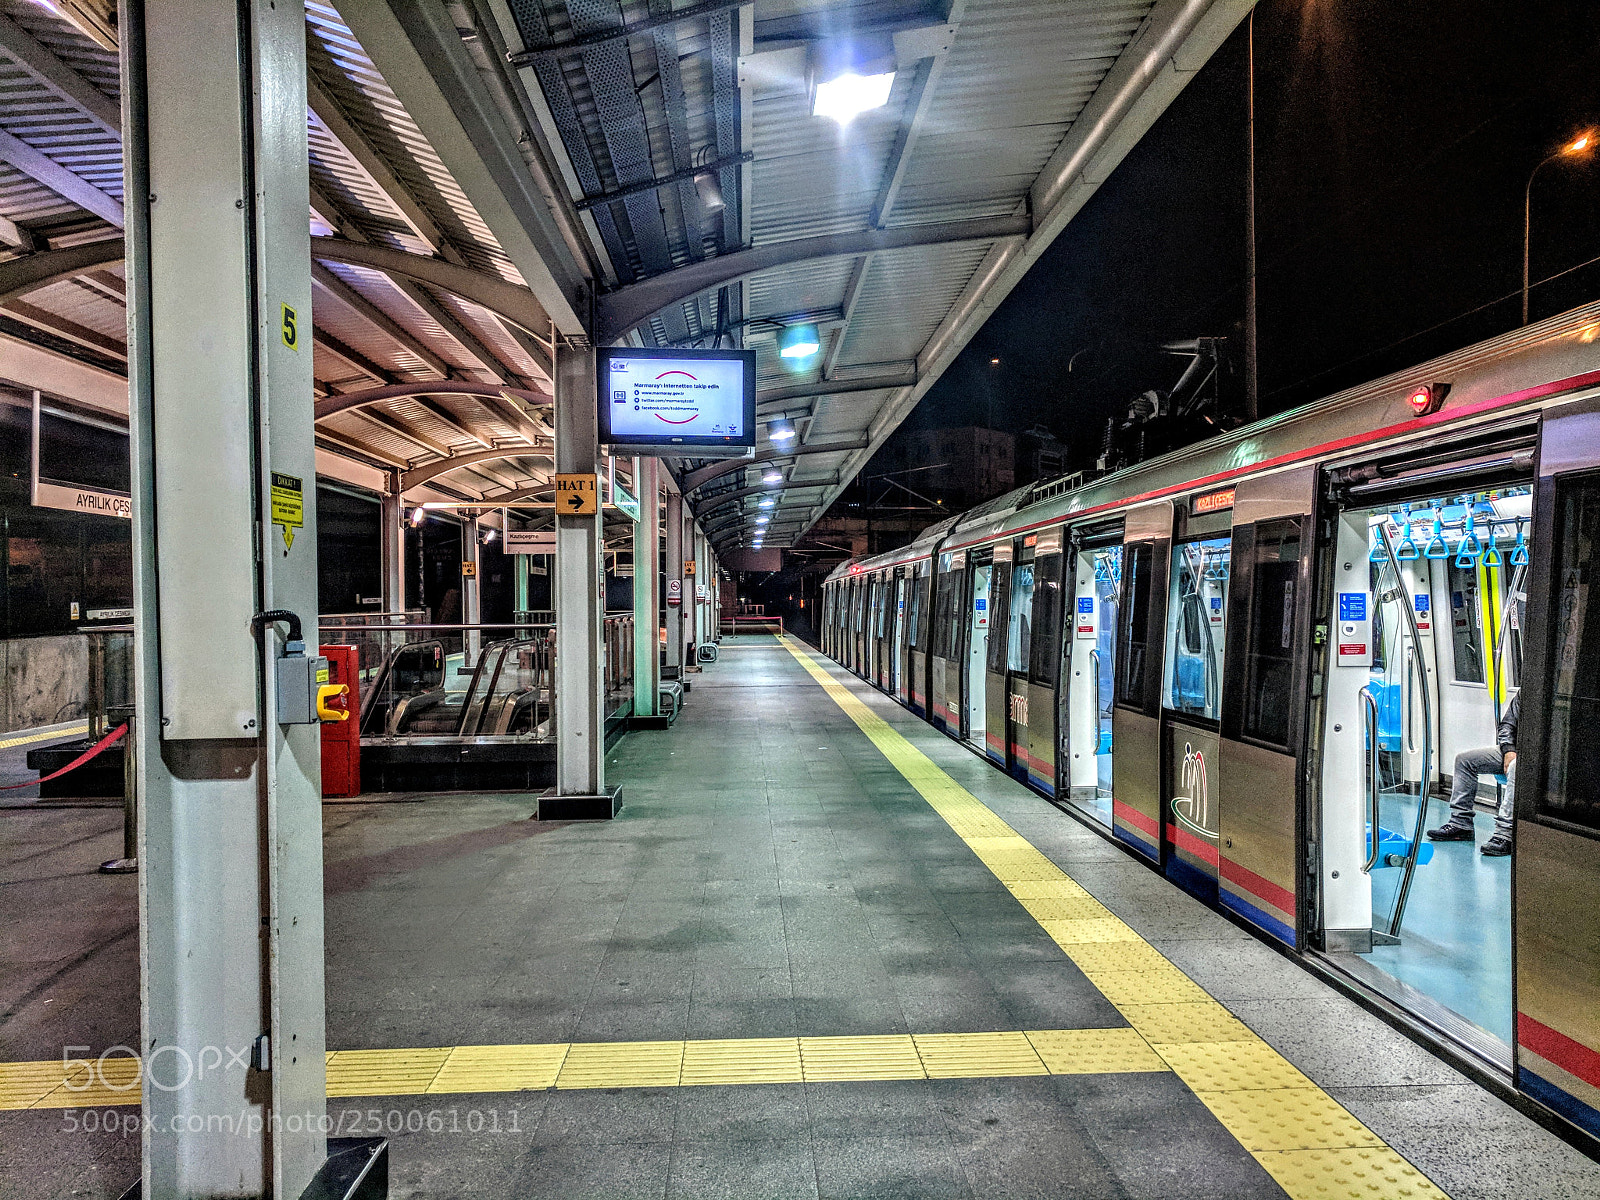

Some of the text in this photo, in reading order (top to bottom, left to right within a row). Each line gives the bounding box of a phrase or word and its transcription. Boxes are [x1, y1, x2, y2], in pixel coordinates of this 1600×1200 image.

[284, 307, 296, 346] 5
[557, 480, 595, 491] HAT 1
[76, 493, 111, 511] AYRILIK
